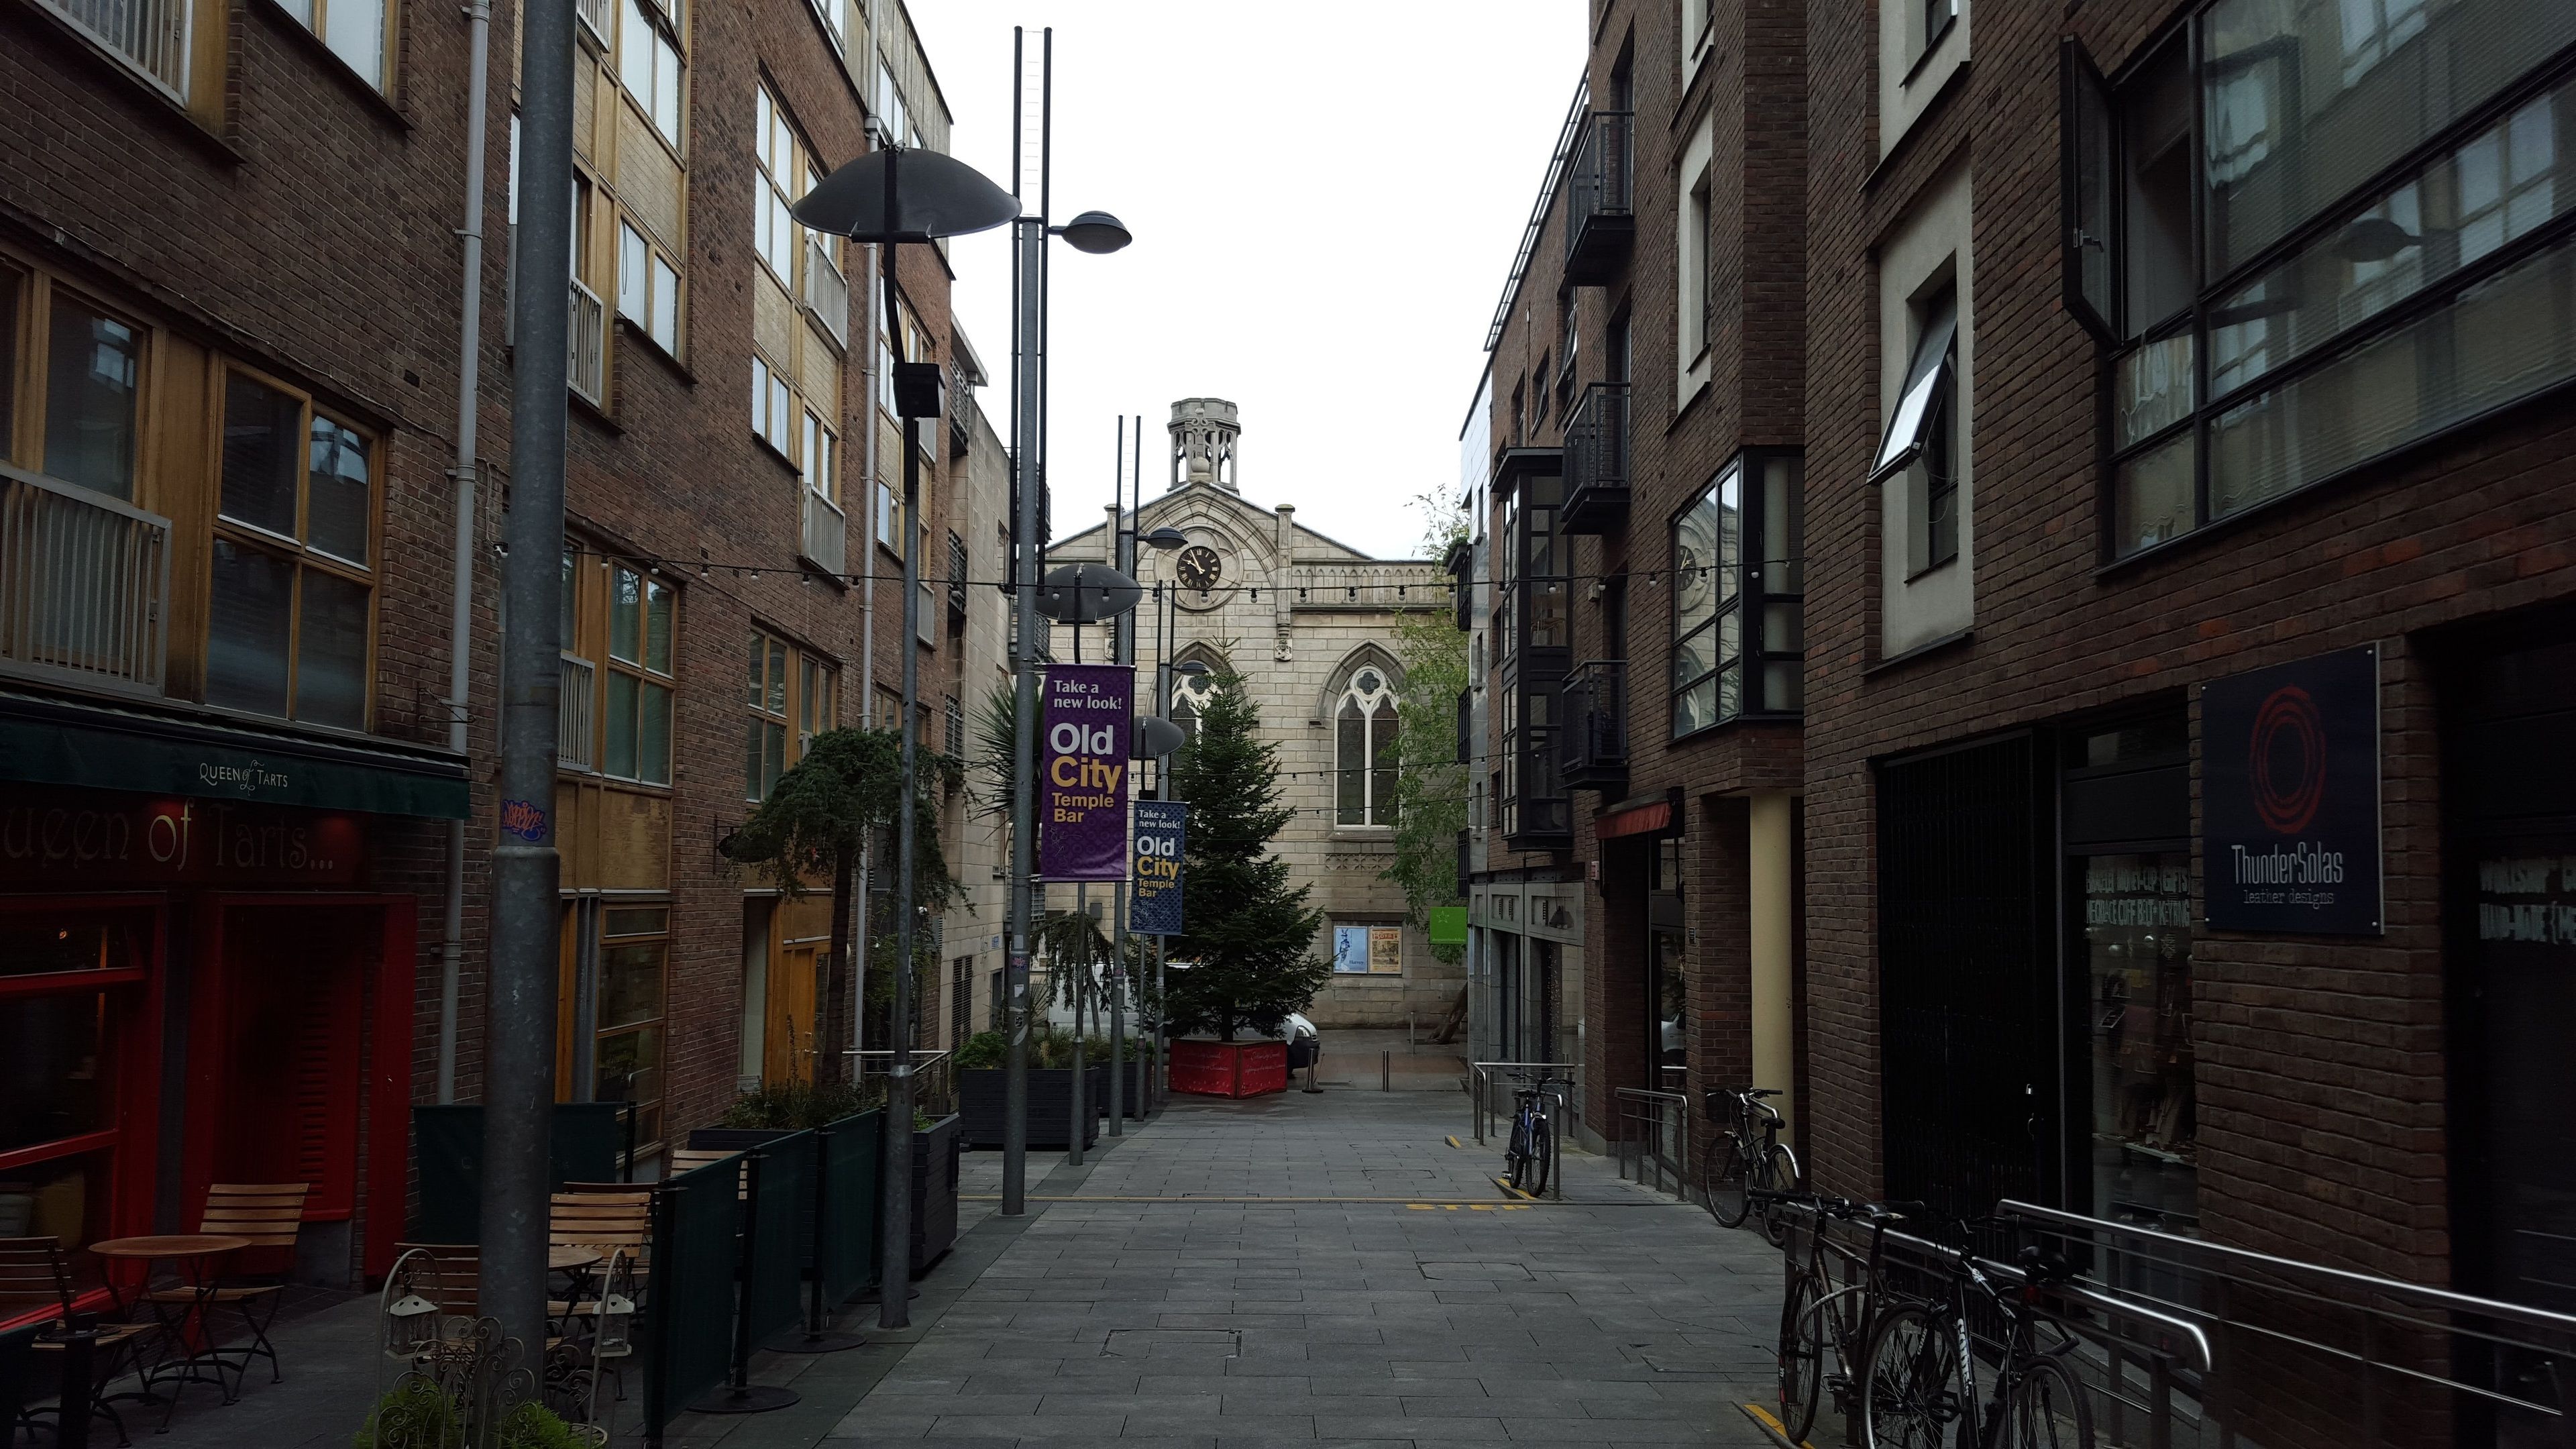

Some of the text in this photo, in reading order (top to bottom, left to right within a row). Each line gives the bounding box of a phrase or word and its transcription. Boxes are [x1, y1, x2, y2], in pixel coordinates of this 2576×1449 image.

[1053, 680, 1099, 694] Take a
[1053, 695, 1122, 710] new look!
[1050, 722, 1114, 755] Old
[199, 762, 241, 786] QUEEN
[256, 769, 288, 788] TARTS
[1051, 755, 1123, 794] City
[1051, 792, 1114, 810] Temple
[1053, 808, 1085, 822] Bar
[1138, 810, 1159, 818] Take
[1159, 820, 1181, 828] look!
[3, 807, 129, 869] ueen
[148, 797, 195, 872] of
[1136, 836, 1175, 856] Old
[1137, 855, 1180, 880] City
[2231, 841, 2344, 884] ThunderSolas
[1138, 878, 1175, 890] Temple
[1138, 888, 1157, 898] Bar
[2243, 888, 2334, 910] leather designs
